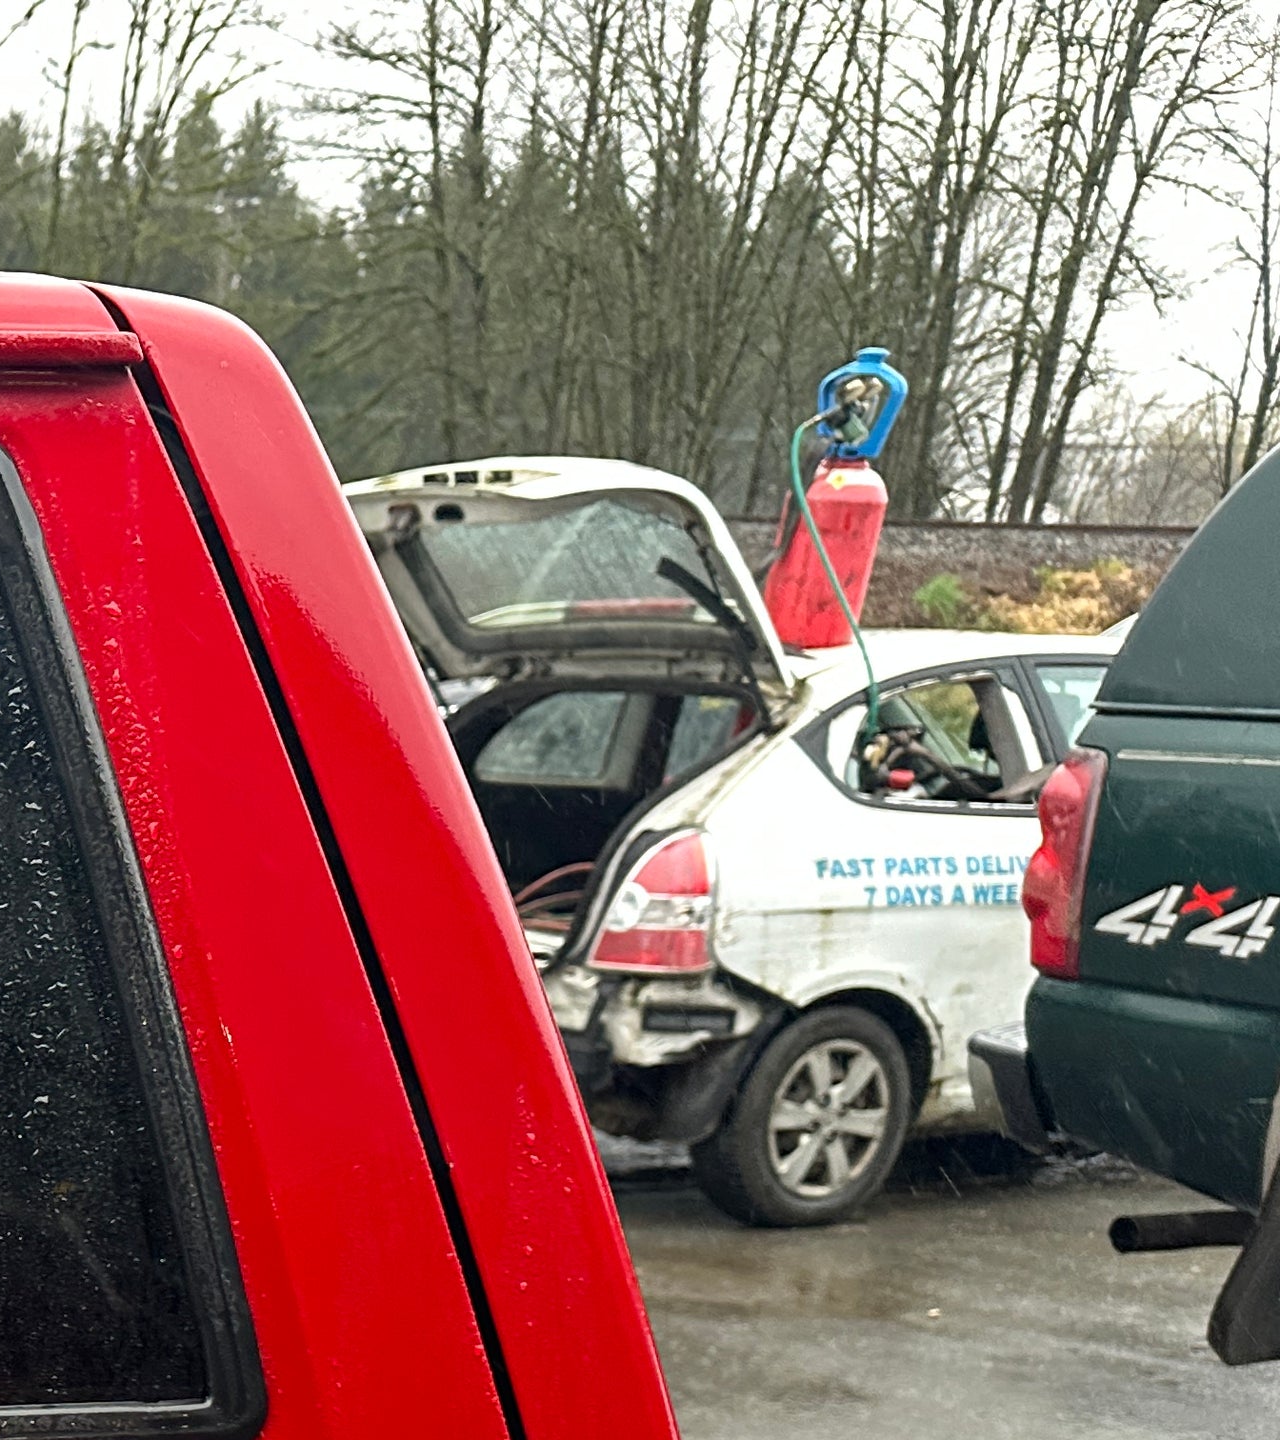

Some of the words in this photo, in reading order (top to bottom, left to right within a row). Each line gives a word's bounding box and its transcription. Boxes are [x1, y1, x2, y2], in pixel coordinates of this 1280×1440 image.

[815, 857, 875, 878] FAST
[885, 856, 958, 876] PARTS
[863, 886, 877, 907] 7
[885, 885, 943, 907] DAYS
[952, 884, 966, 906] A
